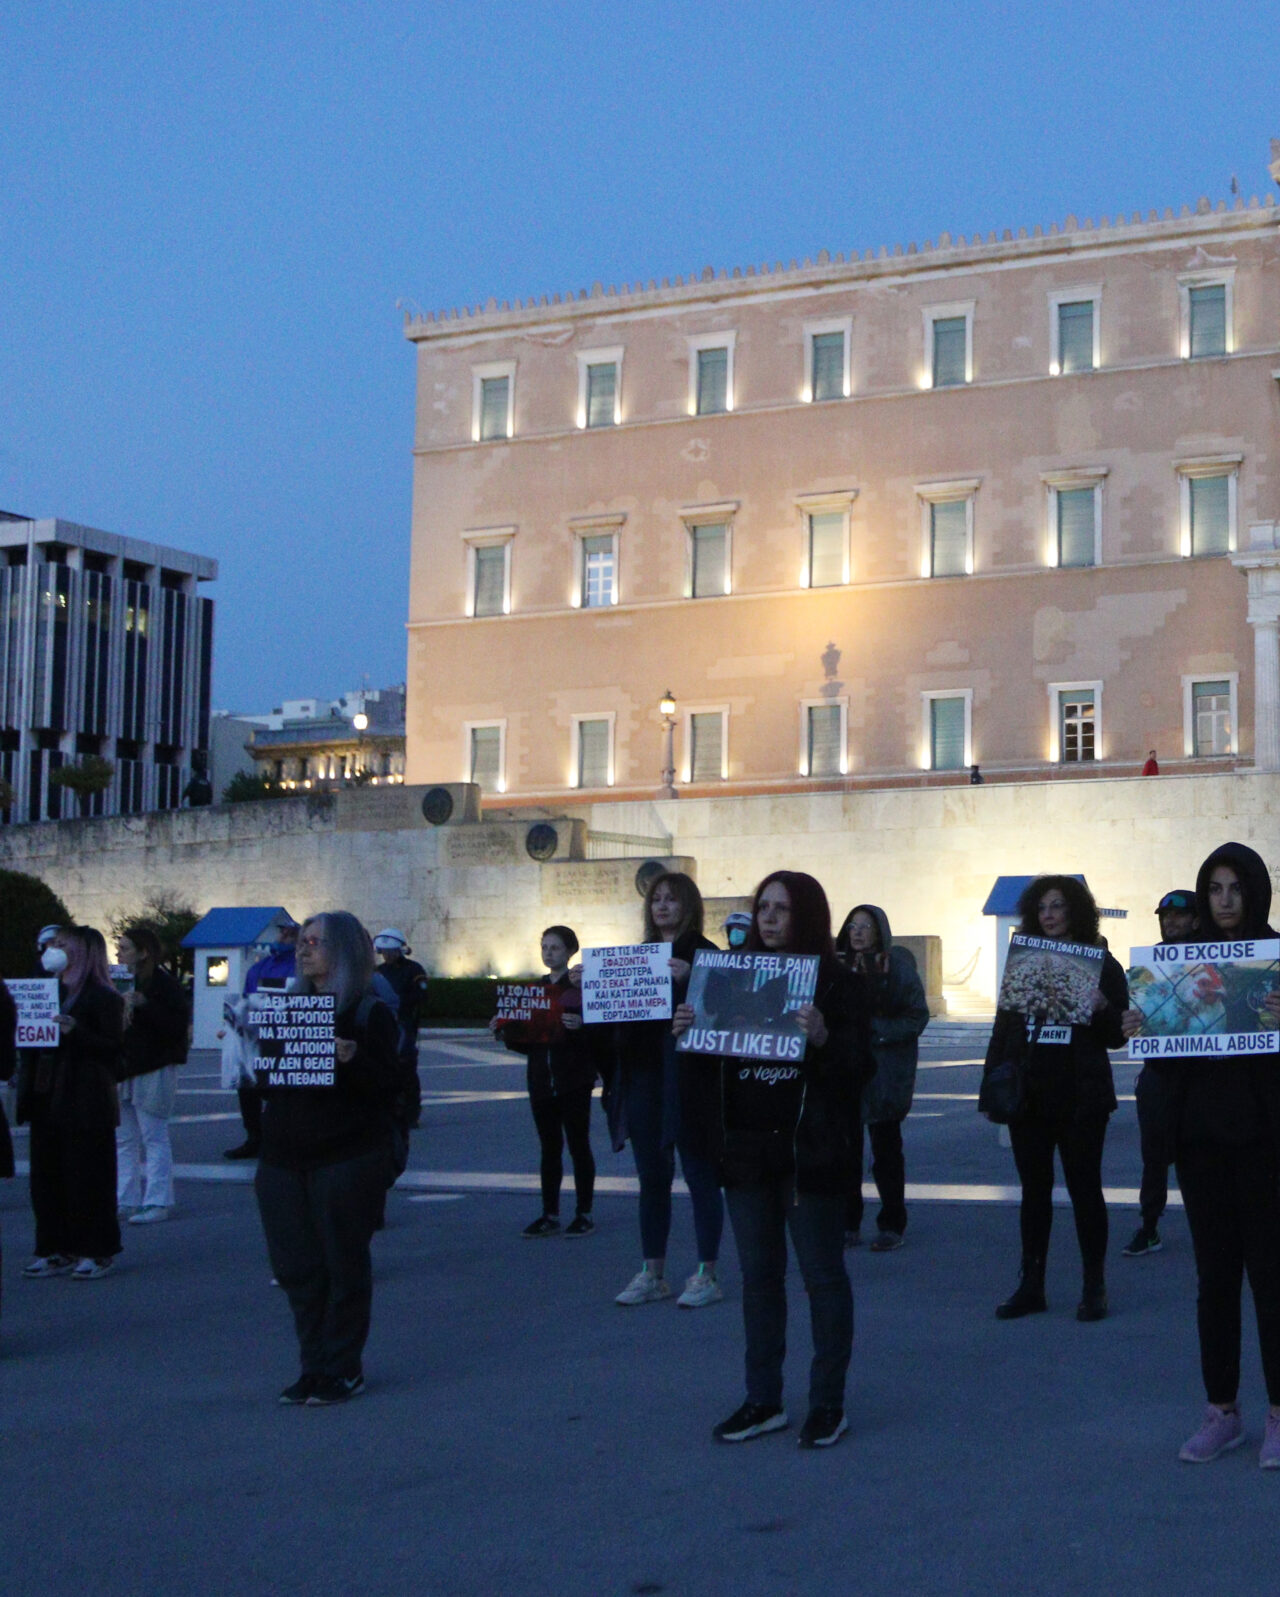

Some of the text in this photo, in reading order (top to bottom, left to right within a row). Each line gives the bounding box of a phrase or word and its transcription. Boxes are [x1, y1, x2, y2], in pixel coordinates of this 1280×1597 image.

[592, 944, 660, 957] ΑΥΤΕΣ ΤΙΣ ΜΕΡΕΣ
[1012, 935, 1104, 959] ΠΕΣ ΟΧΙ ΣΤΗ ΣΦΑΓΗ ΤΟΥΣ
[1153, 943, 1255, 962] NO EXCUSE
[602, 956, 649, 967] ΣΦΑΖΟΝΤΑΙ
[695, 952, 816, 974] ANIMALS FEEL PAIN
[599, 966, 652, 978] ΠΕΡΙΣΣΟΤΕΡΑ
[584, 980, 600, 989] ΑΠΟ
[633, 976, 669, 987] ΑΡΝΑΚΙΑ
[496, 985, 545, 997] Η ΣΦΑΓΗ
[595, 987, 658, 999] ΚΑΙ ΚΑΤΣΙΚΑΚΙΑ
[264, 995, 335, 1009] ΔΕΝ ΥΠΑΡΧΕΙ
[496, 997, 551, 1009] ΔΕΝ ΕΙΝΑΙ
[587, 998, 667, 1010] ΜΟΝΟ ΓΙΑ ΜΙΑ ΜΕΡΑ
[248, 1011, 335, 1024] ΣΩΣΤΟΣ ΤΡΟΠΟΣ
[496, 1008, 532, 1020] ΑΓΑΠΗ
[18, 1026, 56, 1041] EGAN
[258, 1026, 335, 1039] ΝΑ ΣΚΟΤΩΣΕΙΣ
[284, 1042, 336, 1054] ΚΑΠΟΙΟΝ
[680, 1028, 801, 1058] JUST LIKE US
[1132, 1034, 1275, 1054] FOR ANIMAL ABUSE
[254, 1057, 335, 1070] ΠΟΥ ΔΕΝ ΘΕΛΕΙ
[269, 1073, 335, 1085] ΝΑ ΠΕΘΑΝΕΙ
